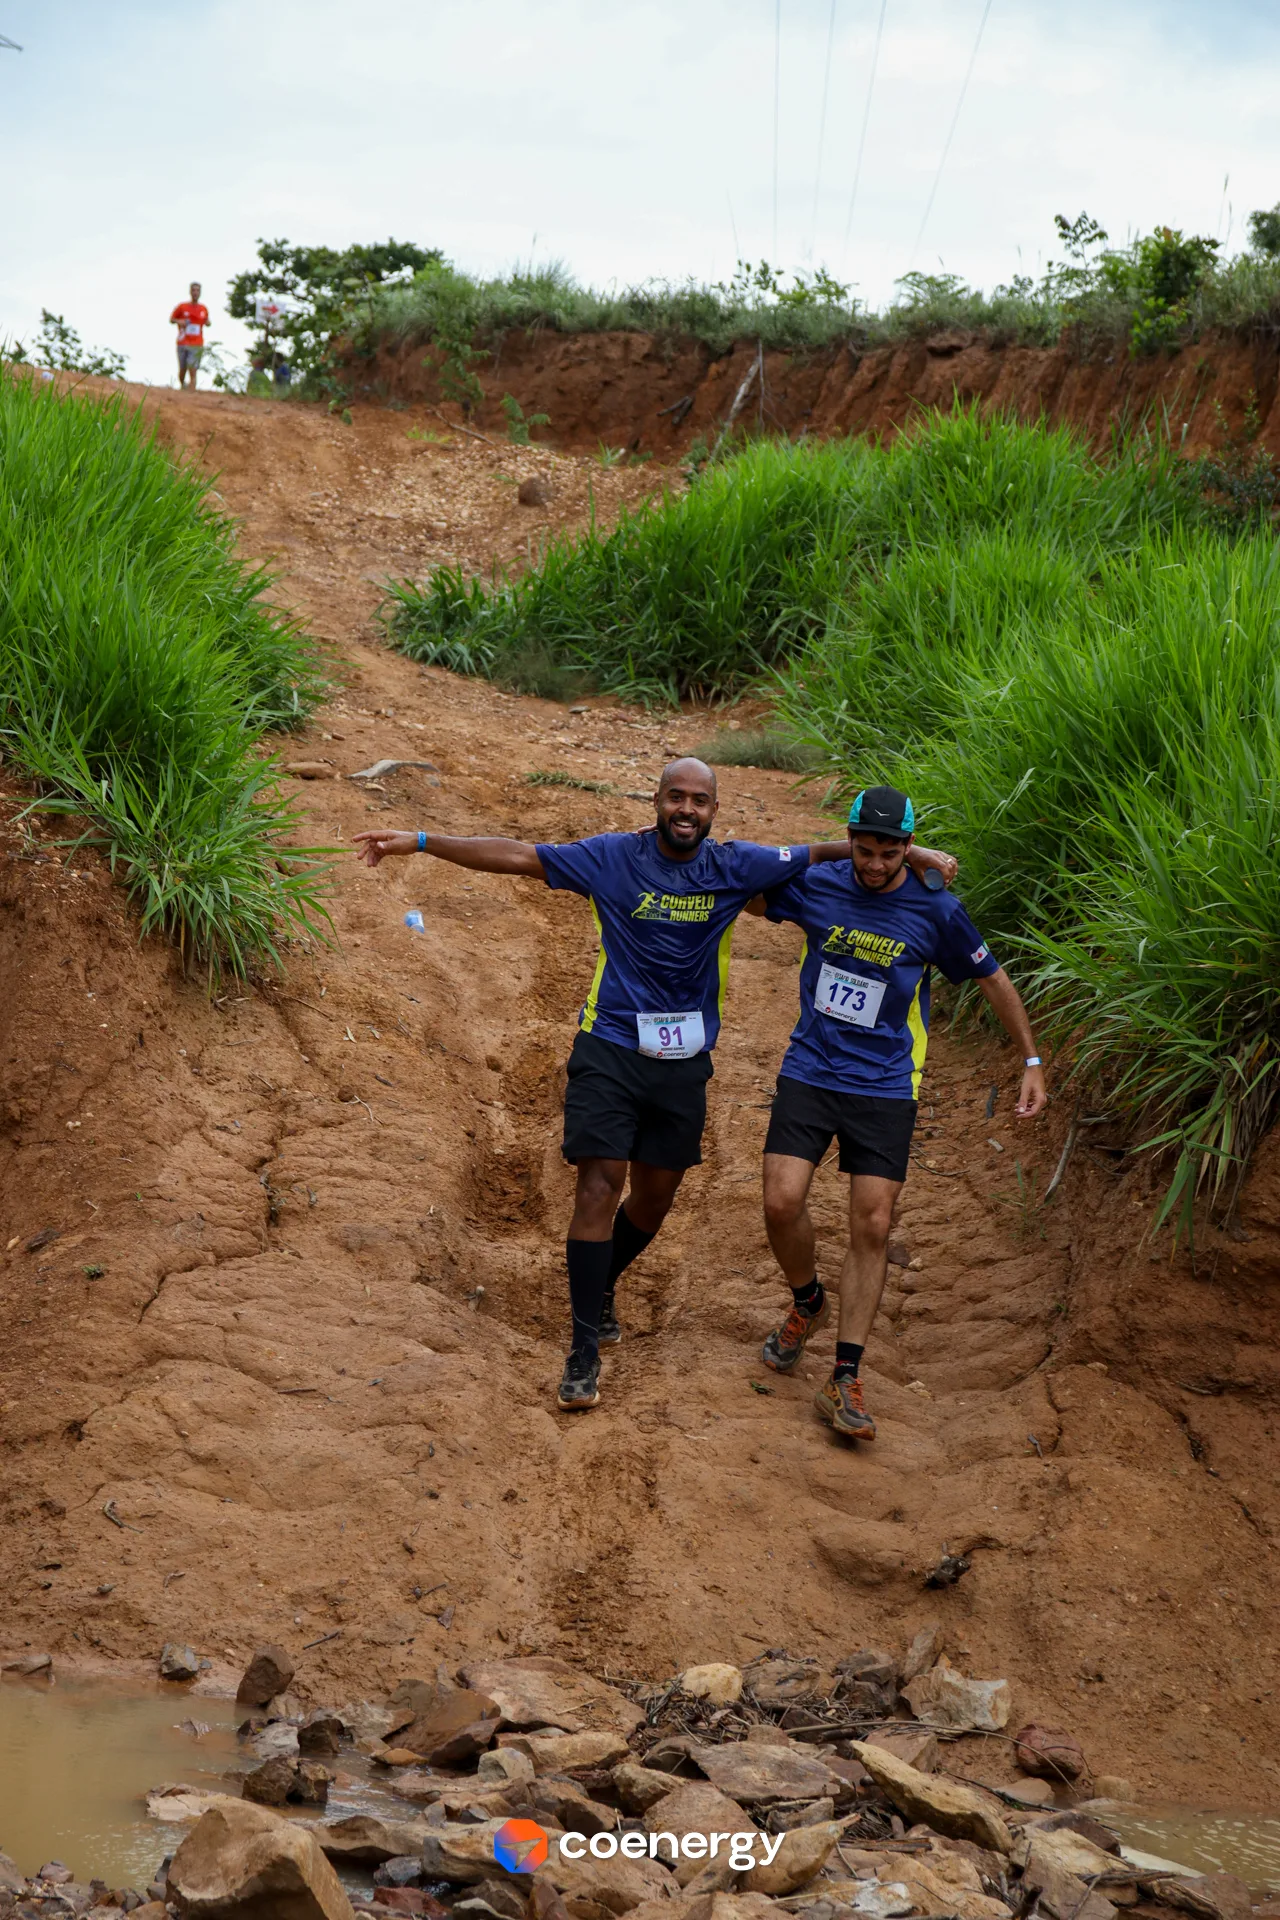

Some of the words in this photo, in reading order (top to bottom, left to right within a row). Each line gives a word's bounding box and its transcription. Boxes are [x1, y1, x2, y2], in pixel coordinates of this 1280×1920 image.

[660, 894, 714, 910] CURVELO
[669, 910, 709, 922] RUNNERS
[846, 929, 906, 957] CURVELO
[852, 946, 894, 968] RUNNERS
[829, 982, 867, 1011] 173
[831, 1009, 857, 1021] coenergy
[658, 1026, 683, 1047] 91
